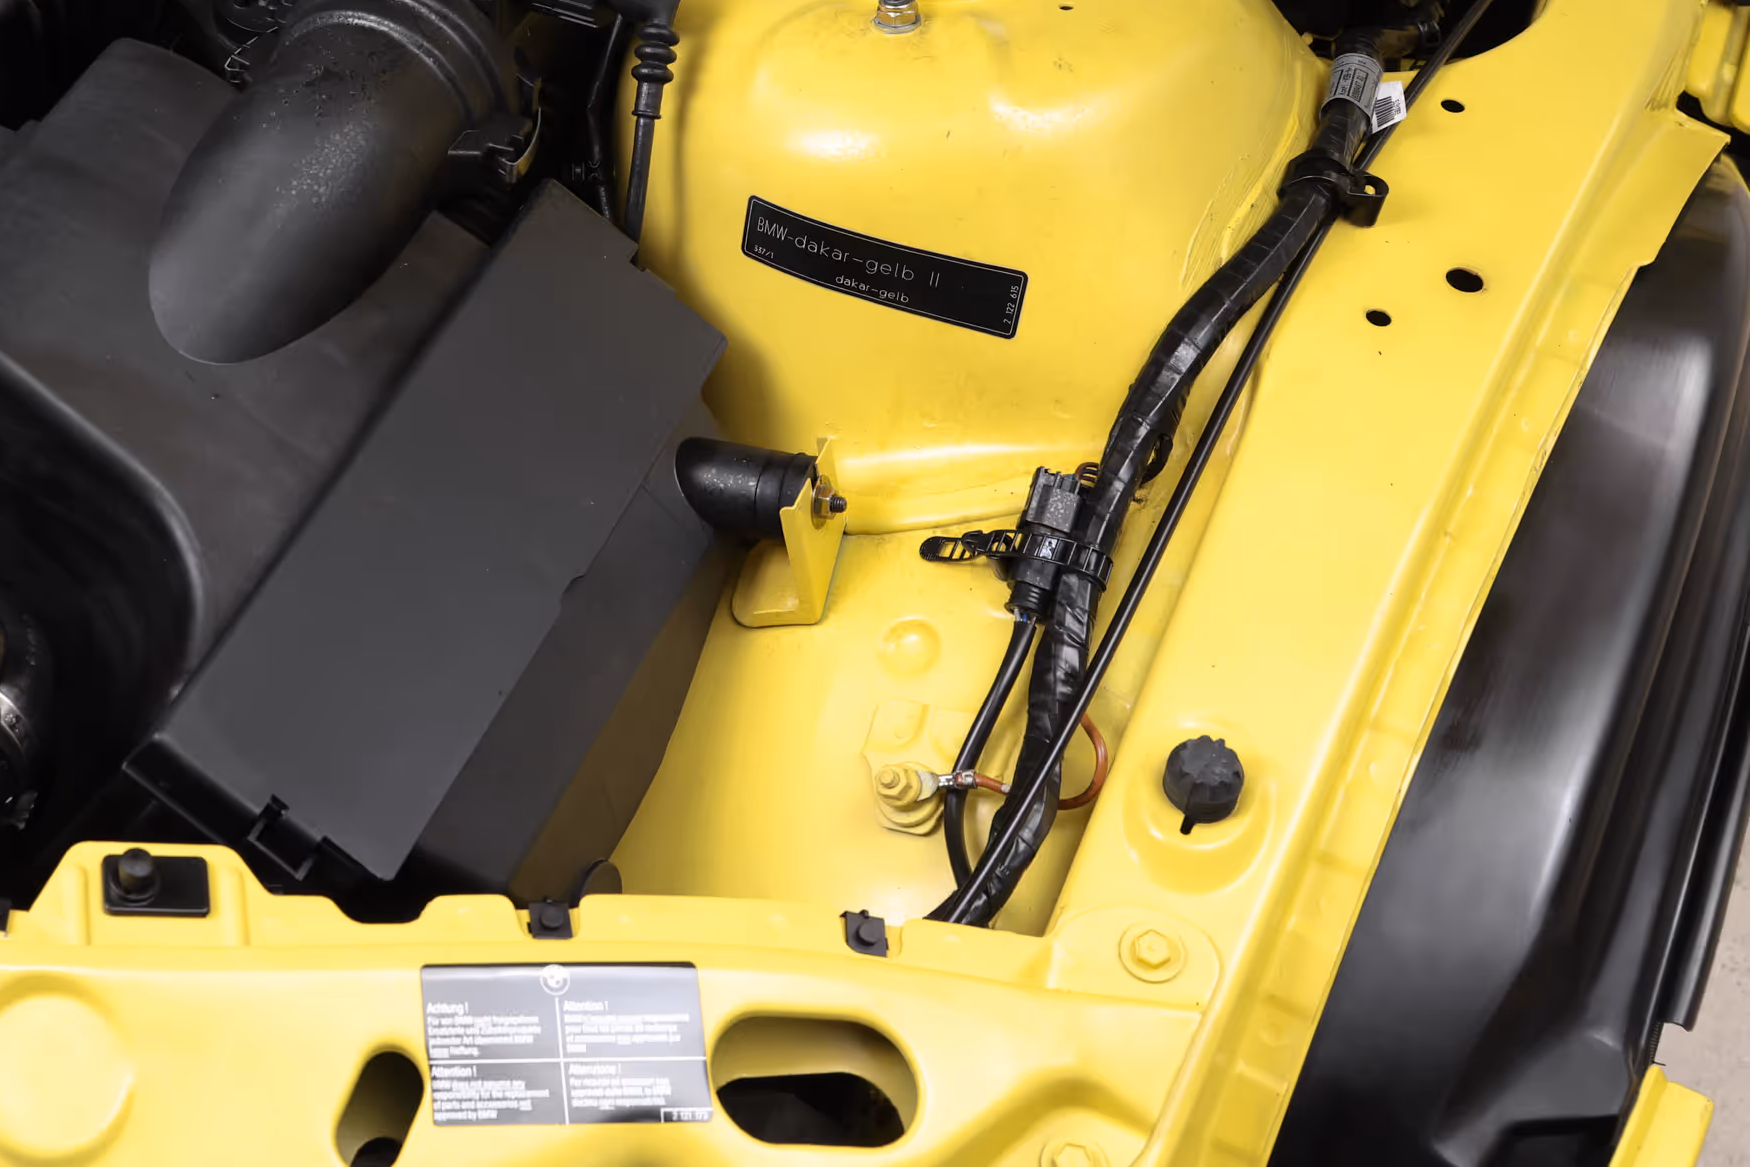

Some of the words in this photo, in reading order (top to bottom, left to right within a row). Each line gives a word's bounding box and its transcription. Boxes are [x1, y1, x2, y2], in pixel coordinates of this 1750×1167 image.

[753, 244, 775, 259] 337/1
[756, 216, 915, 281] BMW-dakar-gelb
[835, 275, 909, 303] dakar-gelb
[1009, 285, 1020, 299] 615
[1005, 302, 1015, 315] 122
